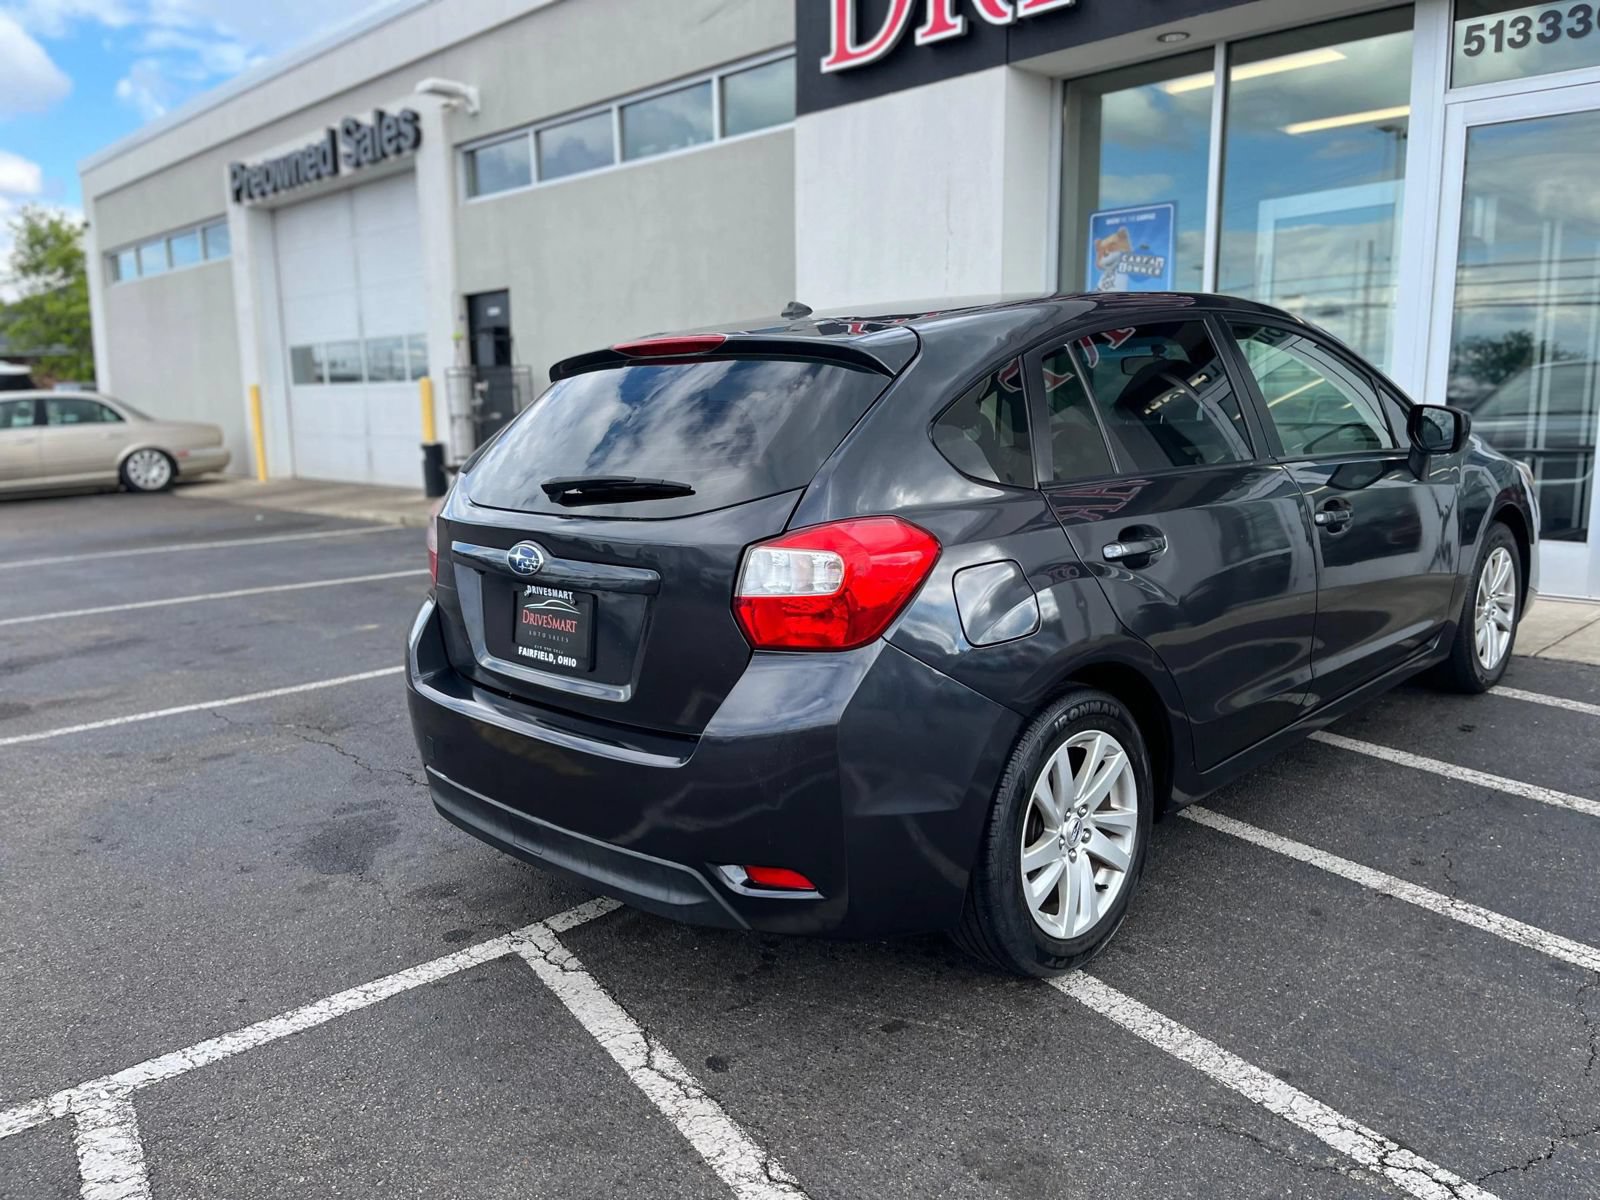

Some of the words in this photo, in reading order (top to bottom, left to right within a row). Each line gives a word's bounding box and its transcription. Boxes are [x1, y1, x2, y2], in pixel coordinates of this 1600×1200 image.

[1463, 3, 1600, 57] 51333
[229, 127, 339, 202] Preowned
[341, 108, 422, 168] Sales
[527, 585, 573, 600] DRIVESMART
[518, 646, 556, 664] FAIRFIELD,
[558, 656, 577, 667] OHIO
[1054, 702, 1119, 731] IRONMAN
